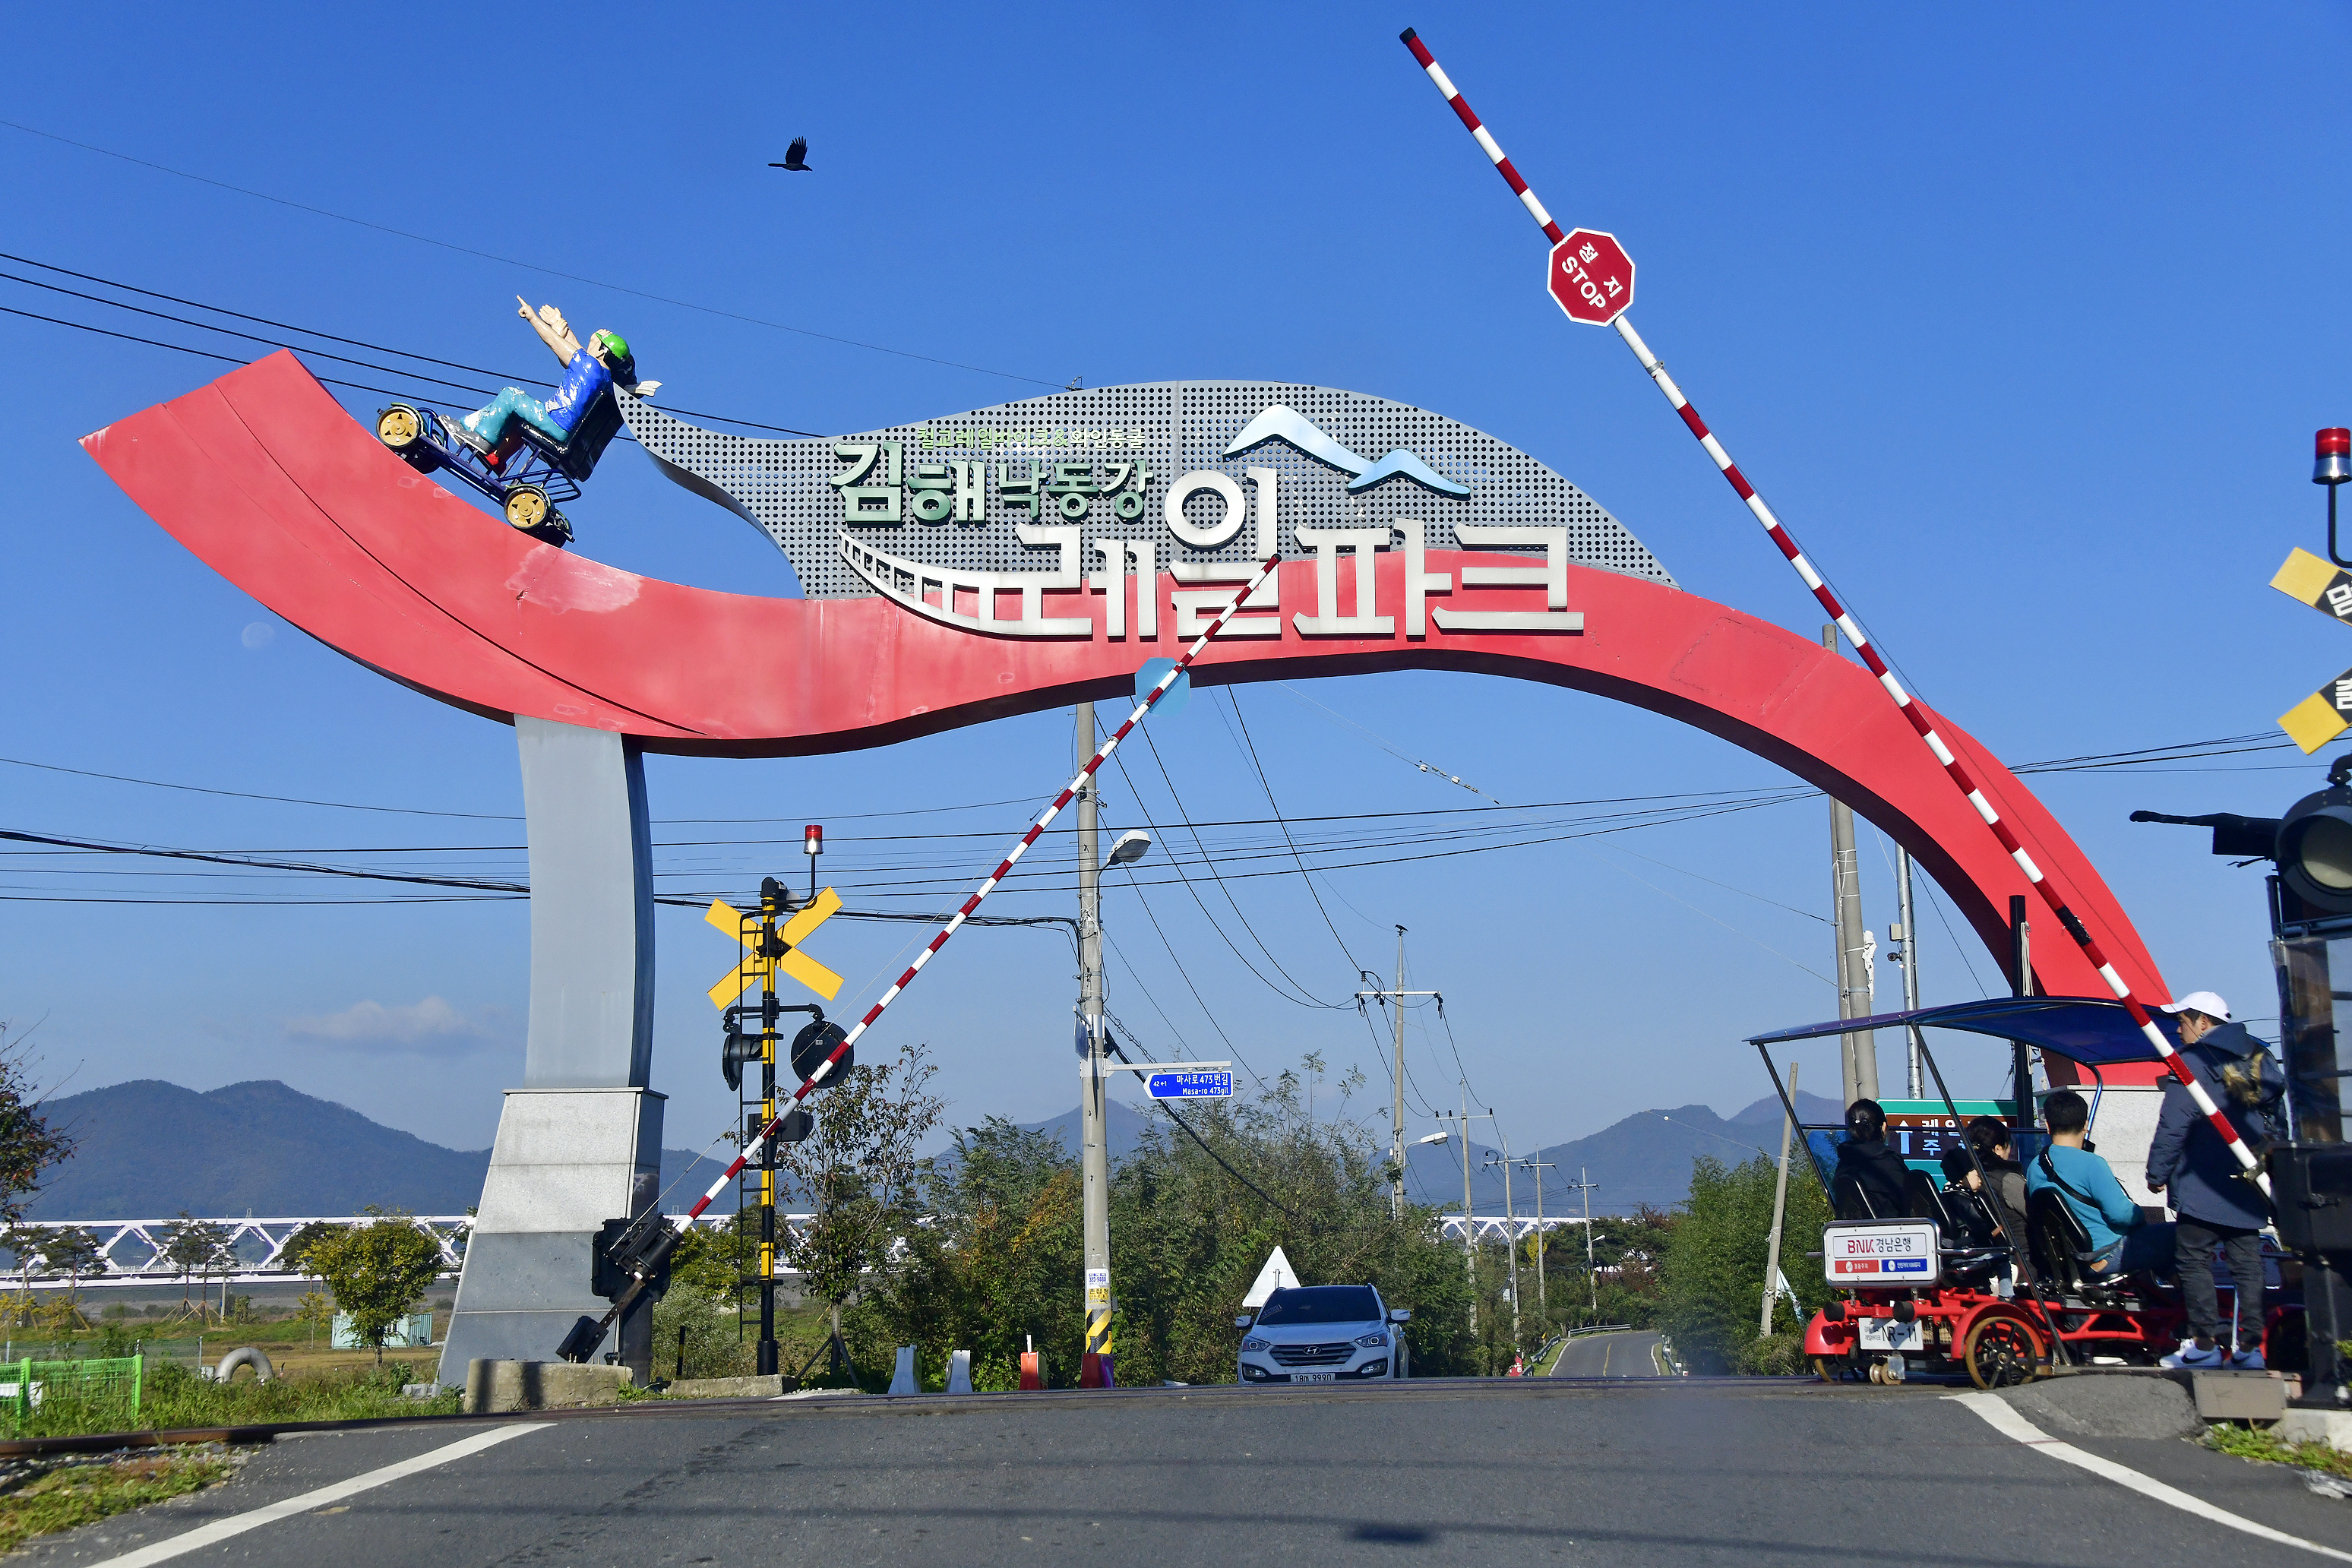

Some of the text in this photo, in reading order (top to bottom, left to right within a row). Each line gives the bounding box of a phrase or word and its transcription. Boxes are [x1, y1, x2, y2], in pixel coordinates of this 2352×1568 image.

[1561, 256, 1606, 308] STOP
[830, 441, 1154, 523] 김해 낙동강
[836, 466, 1585, 638] 레일파크
[1176, 1073, 1228, 1086] 마사로473번길
[1209, 1086, 1229, 1095] 473gil
[1848, 1237, 1911, 1253] BNK 경남은행
[1882, 1325, 1917, 1342] NR-11
